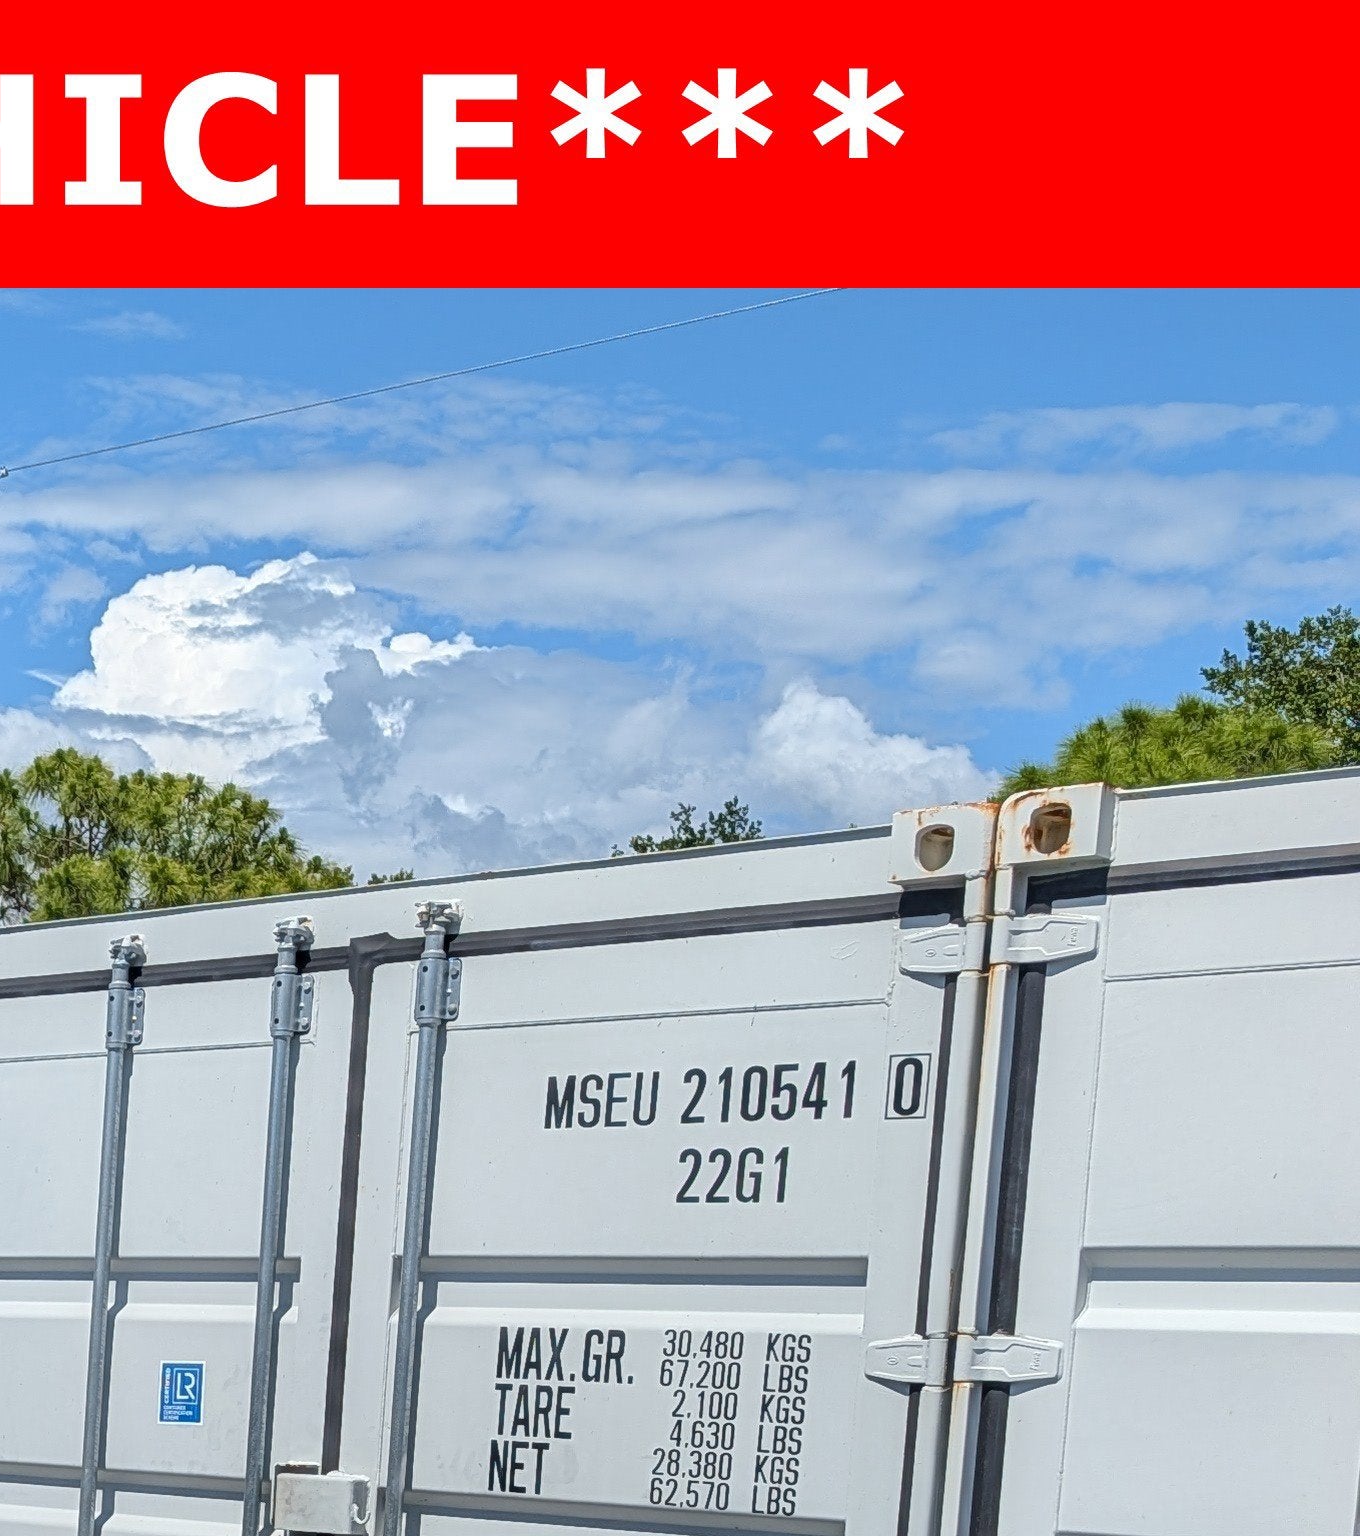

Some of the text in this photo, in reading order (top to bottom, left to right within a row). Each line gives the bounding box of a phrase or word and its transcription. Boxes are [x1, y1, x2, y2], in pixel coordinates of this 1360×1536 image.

[544, 1057, 924, 1130] MSEU 210541 0
[676, 1147, 790, 1204] 22G1
[662, 1329, 813, 1364] 30,480 KGS
[176, 1372, 196, 1400] LR
[659, 1359, 809, 1395] 67,200 LBS
[495, 1383, 576, 1440] TARE
[671, 1390, 807, 1425] 2,100 KGS
[670, 1420, 803, 1456] 4,630 LBS
[488, 1439, 550, 1495] NET
[651, 1448, 800, 1486] 28,380 KGS
[649, 1478, 796, 1517] 62,570 LBS
